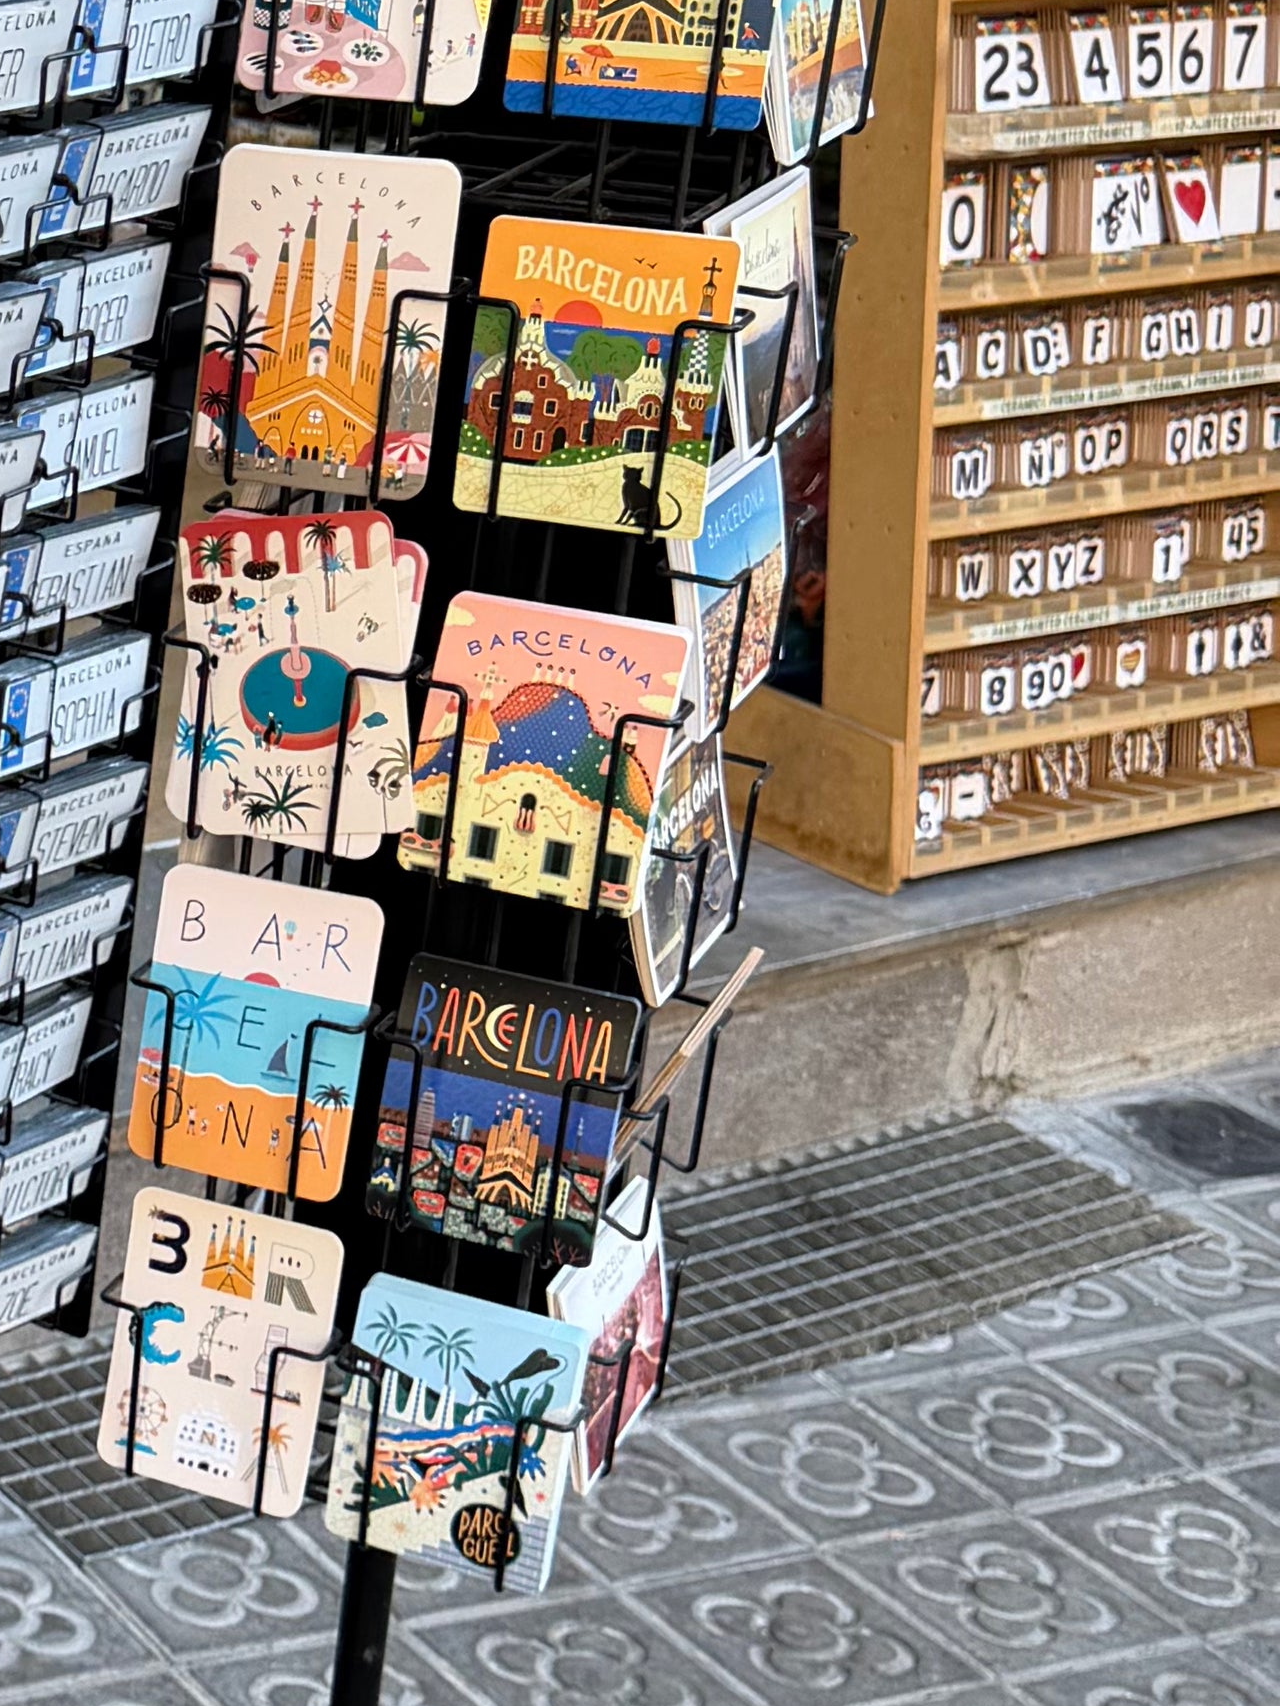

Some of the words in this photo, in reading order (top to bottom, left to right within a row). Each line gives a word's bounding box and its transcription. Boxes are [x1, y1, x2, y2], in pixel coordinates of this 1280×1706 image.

[127, 12, 192, 73] PIETRO
[1084, 37, 1110, 93] 4
[1137, 32, 1163, 89] 5
[1179, 28, 1204, 85] 6
[1233, 24, 1259, 82] 7
[104, 125, 190, 157] BARCELONA
[250, 171, 422, 229] BARCELONA
[514, 244, 689, 317] BARCELONA
[706, 483, 765, 549] BARCELONA
[50, 653, 133, 689] ARCELONA
[466, 629, 653, 689] BARCELONA
[52, 688, 118, 747] SOPHIA
[254, 764, 353, 778] BARCELOA
[39, 781, 127, 822] BARCELONA
[36, 811, 110, 867] STEVEN
[22, 897, 111, 941] BARCELONA
[16, 928, 93, 989] TATIANA
[411, 981, 613, 1086] BARCELONA
[9, 1043, 58, 1101] RACY
[1, 1132, 88, 1178] BARCELONA
[0, 1160, 71, 1217] VICTOR
[458, 1507, 504, 1540] PARC
